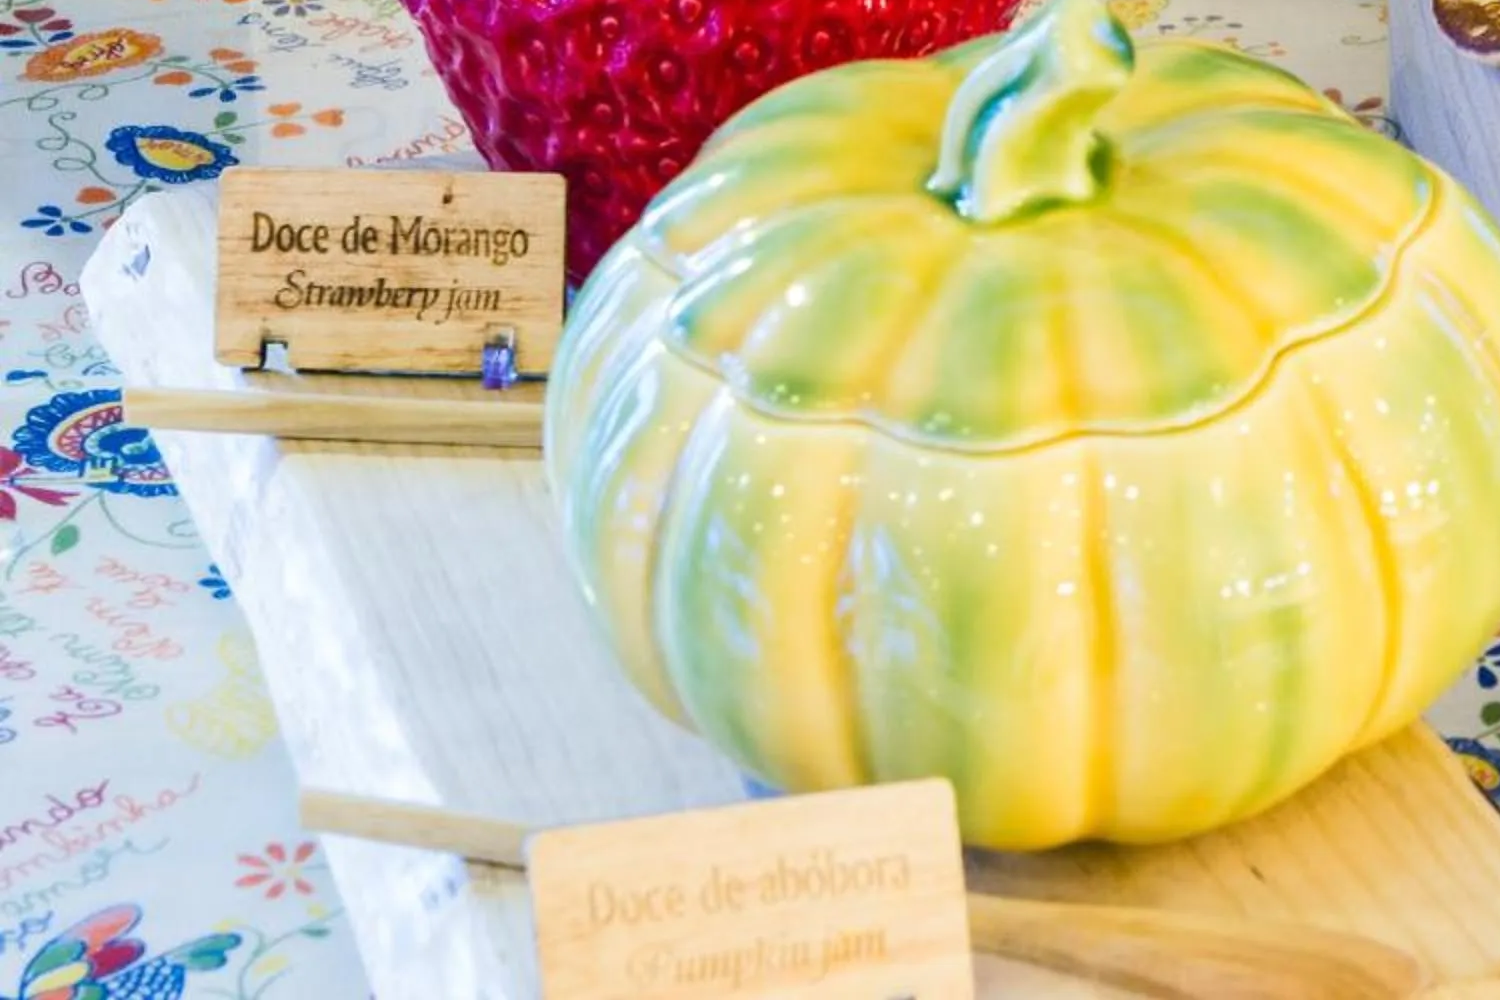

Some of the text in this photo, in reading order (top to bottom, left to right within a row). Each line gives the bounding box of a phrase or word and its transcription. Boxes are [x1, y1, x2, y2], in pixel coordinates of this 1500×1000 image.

[250, 211, 530, 267] Doce de Morango
[434, 278, 502, 325] jam
[587, 881, 686, 926] Doce
[699, 864, 742, 915] de
